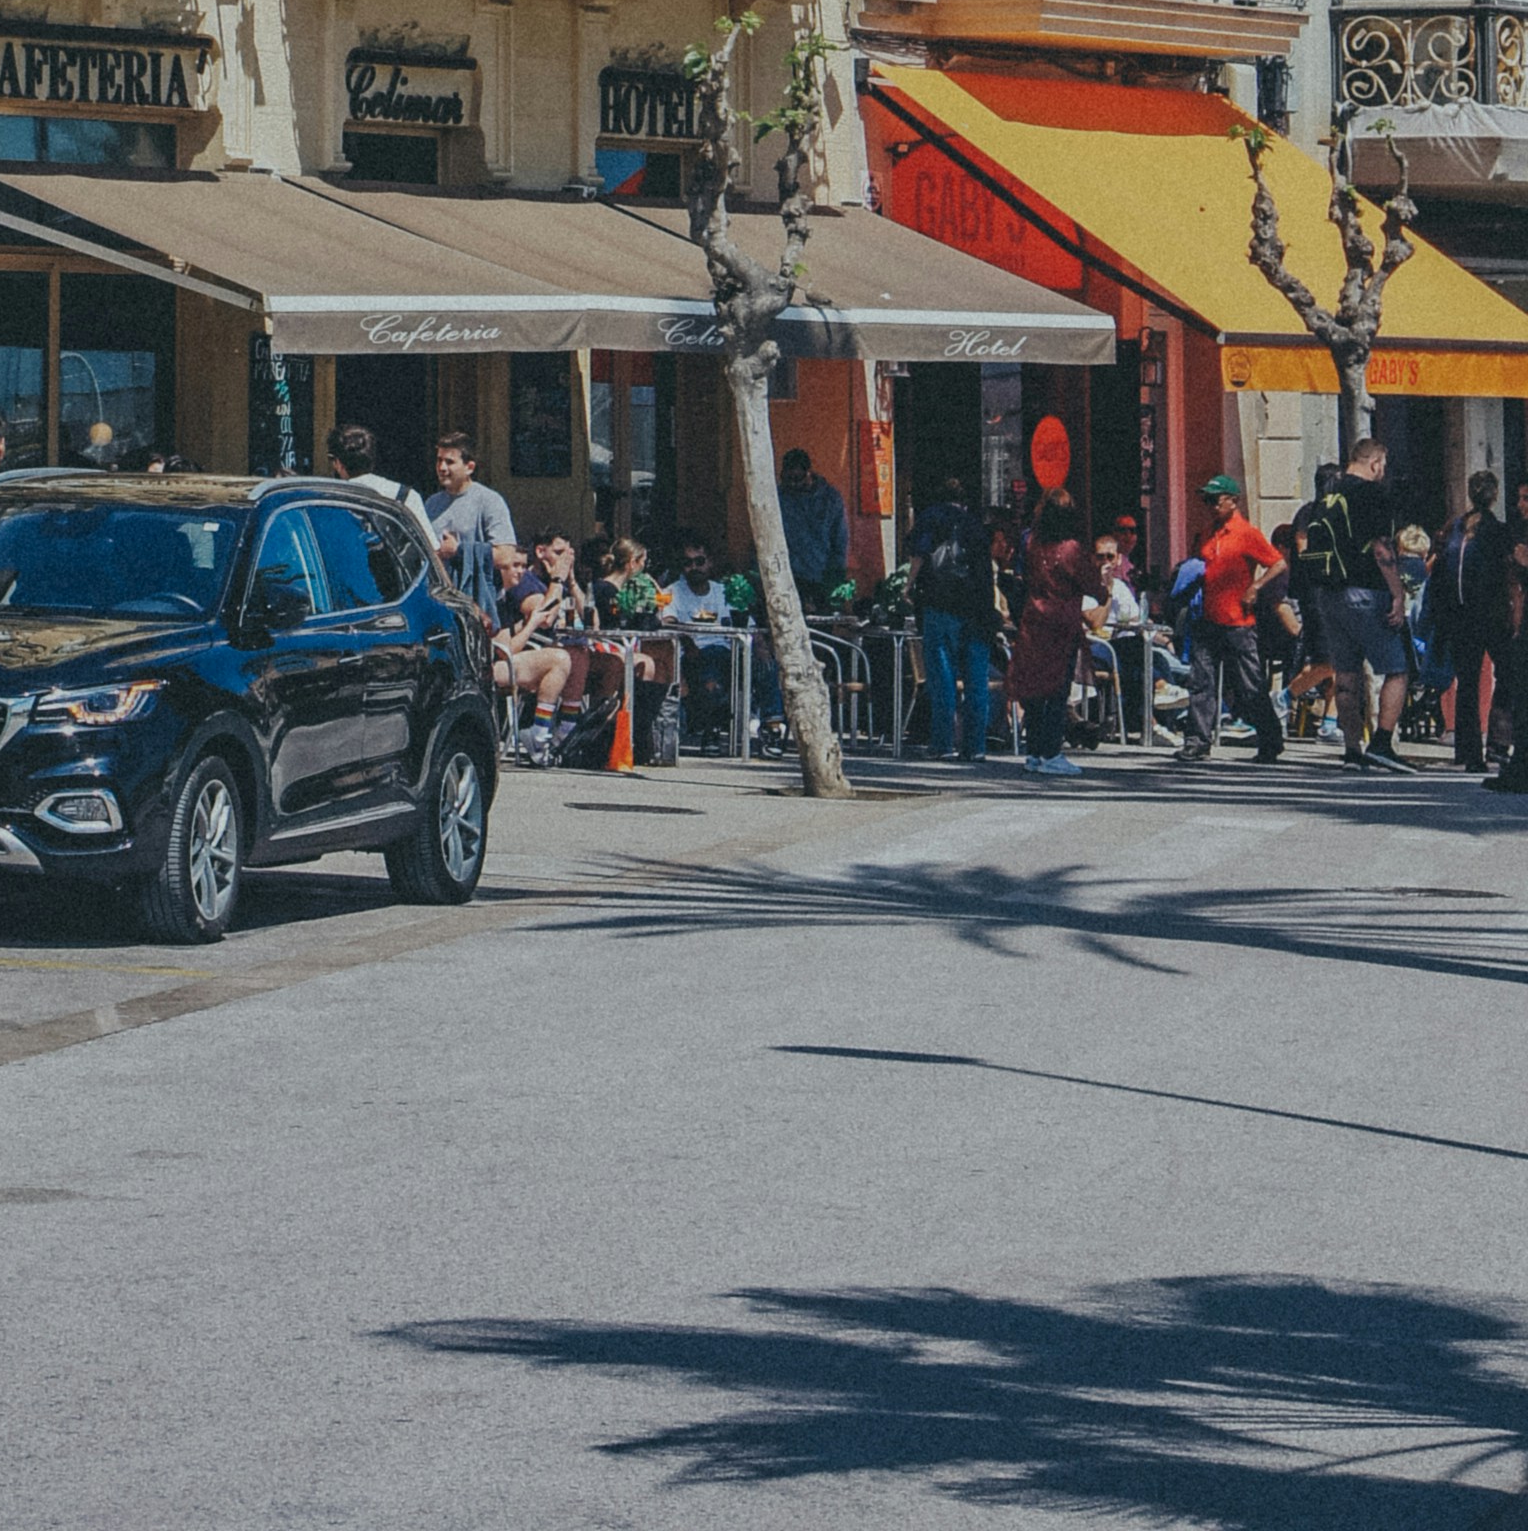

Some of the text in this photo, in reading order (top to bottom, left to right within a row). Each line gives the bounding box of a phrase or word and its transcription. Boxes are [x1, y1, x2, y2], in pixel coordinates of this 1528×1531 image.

[345, 64, 464, 125] Celimar
[360, 314, 502, 351] Cafeteria
[944, 330, 1028, 358] Hotel
[1369, 357, 1420, 386] GABY'S
